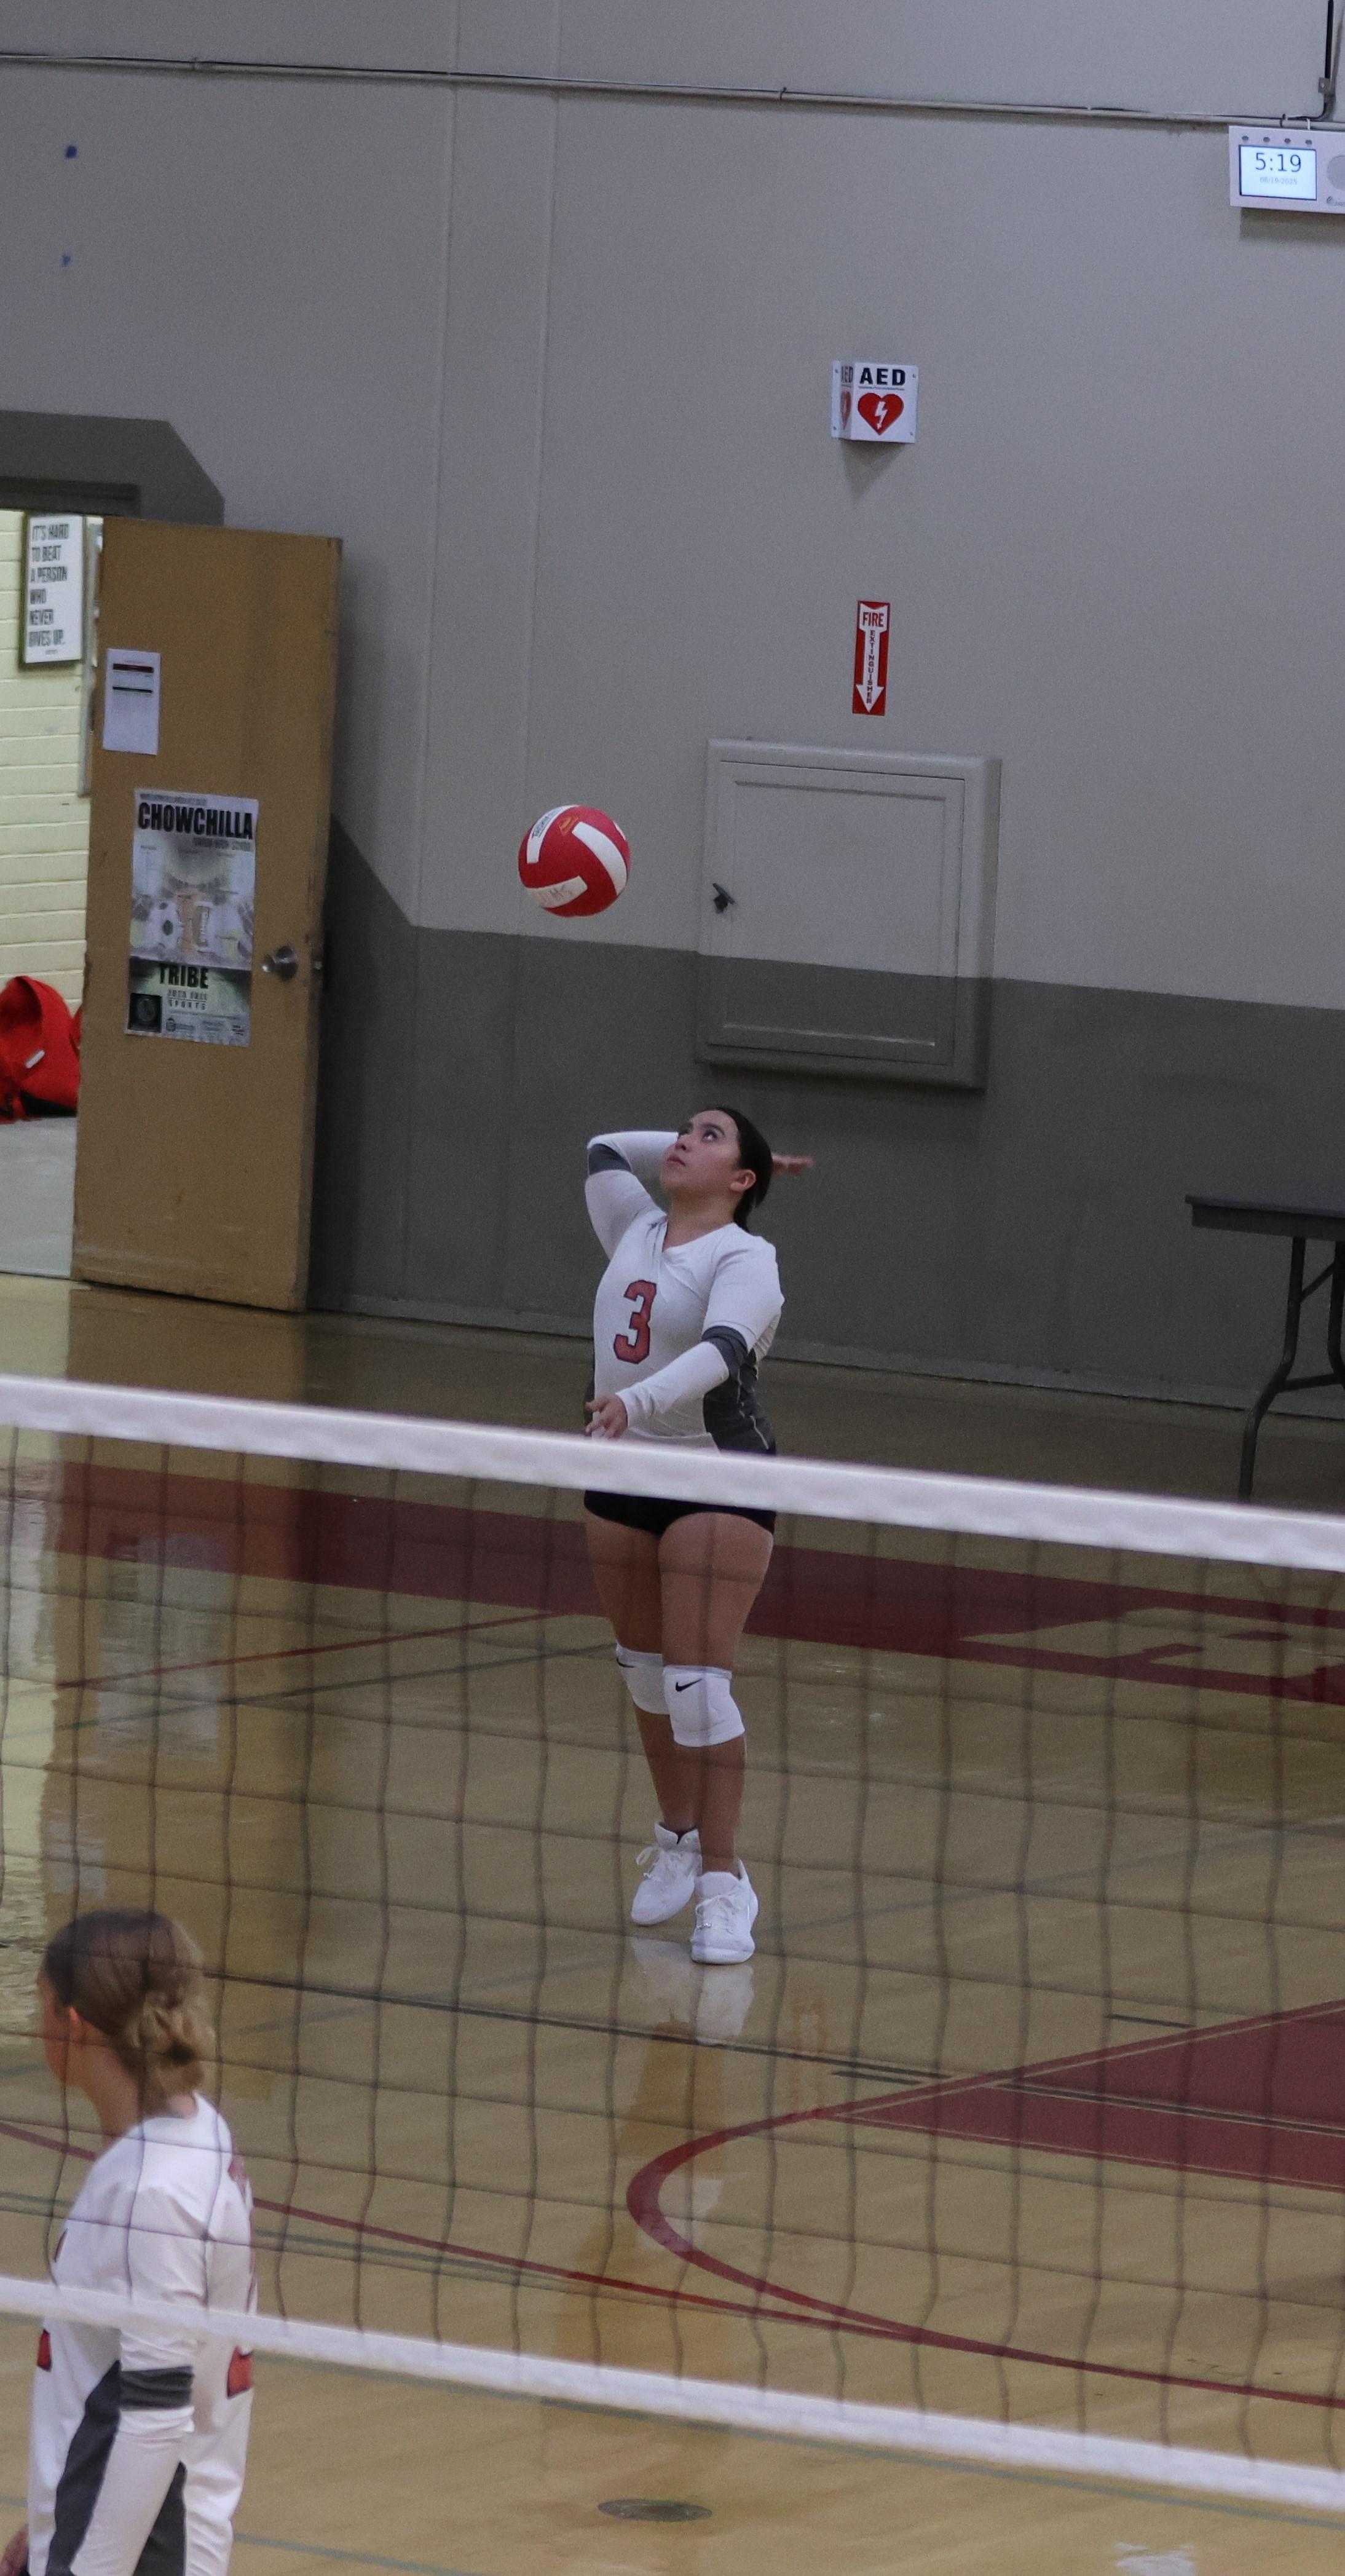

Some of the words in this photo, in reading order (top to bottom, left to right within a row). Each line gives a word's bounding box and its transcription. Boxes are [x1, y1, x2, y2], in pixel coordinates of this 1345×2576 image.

[1255, 152, 1301, 172] 5:19
[859, 368, 905, 385] AED
[33, 525, 46, 541] IT'S
[49, 524, 69, 539] HARD
[32, 547, 41, 562] TO
[42, 545, 61, 561] BEAT
[30, 568, 35, 582] A
[37, 566, 67, 582] PERSON
[30, 588, 47, 604] WHO
[30, 609, 53, 625] NEVER
[862, 612, 884, 627] FIRE
[29, 630, 50, 647] GIVES
[866, 630, 875, 704] EXTINGUISHER
[138, 802, 253, 840] CHOWCHILLA
[159, 963, 209, 989] TRIBE
[168, 1000, 206, 1010] SPORTS
[614, 1280, 657, 1364] 3
